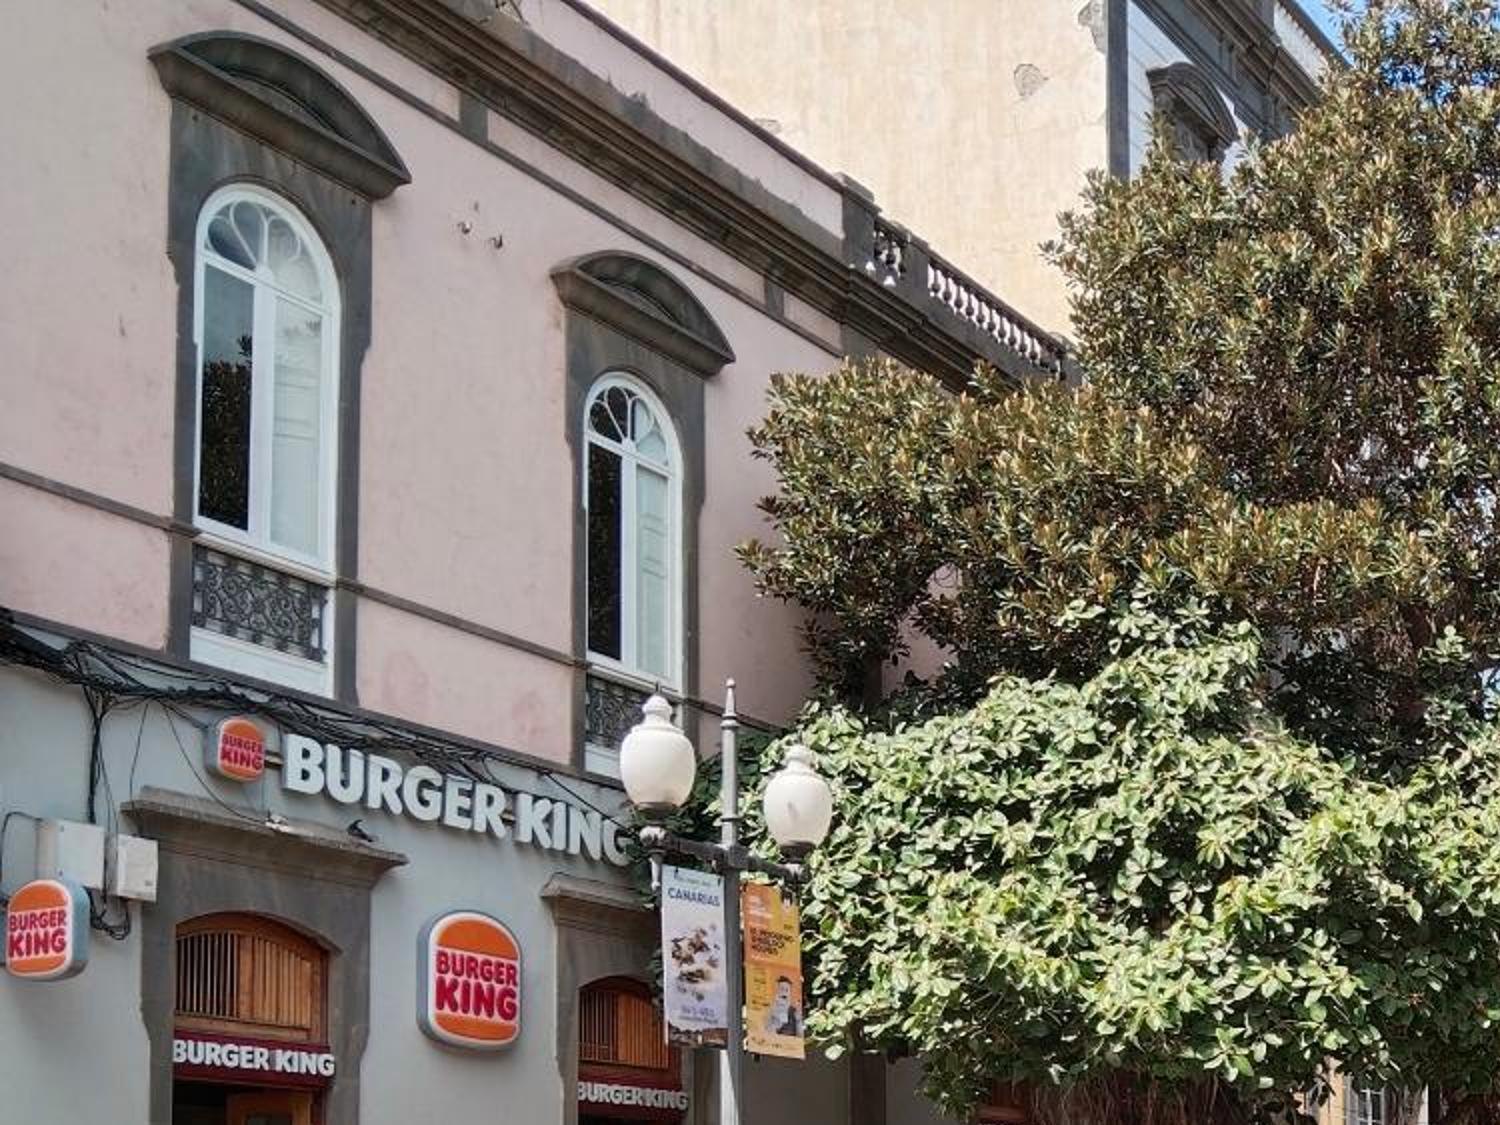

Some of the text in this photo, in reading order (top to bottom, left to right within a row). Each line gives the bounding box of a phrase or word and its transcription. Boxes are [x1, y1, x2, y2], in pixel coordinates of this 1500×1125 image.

[222, 733, 263, 752] BURGER
[221, 750, 263, 770] KING
[284, 733, 633, 867] BURGER KING
[9, 909, 66, 932] BURGER
[9, 928, 65, 958] KING
[436, 949, 517, 987] BURGER
[436, 975, 517, 1021] KING
[173, 1039, 335, 1077] BURGER KING
[577, 1081, 688, 1110] BURGER KING
